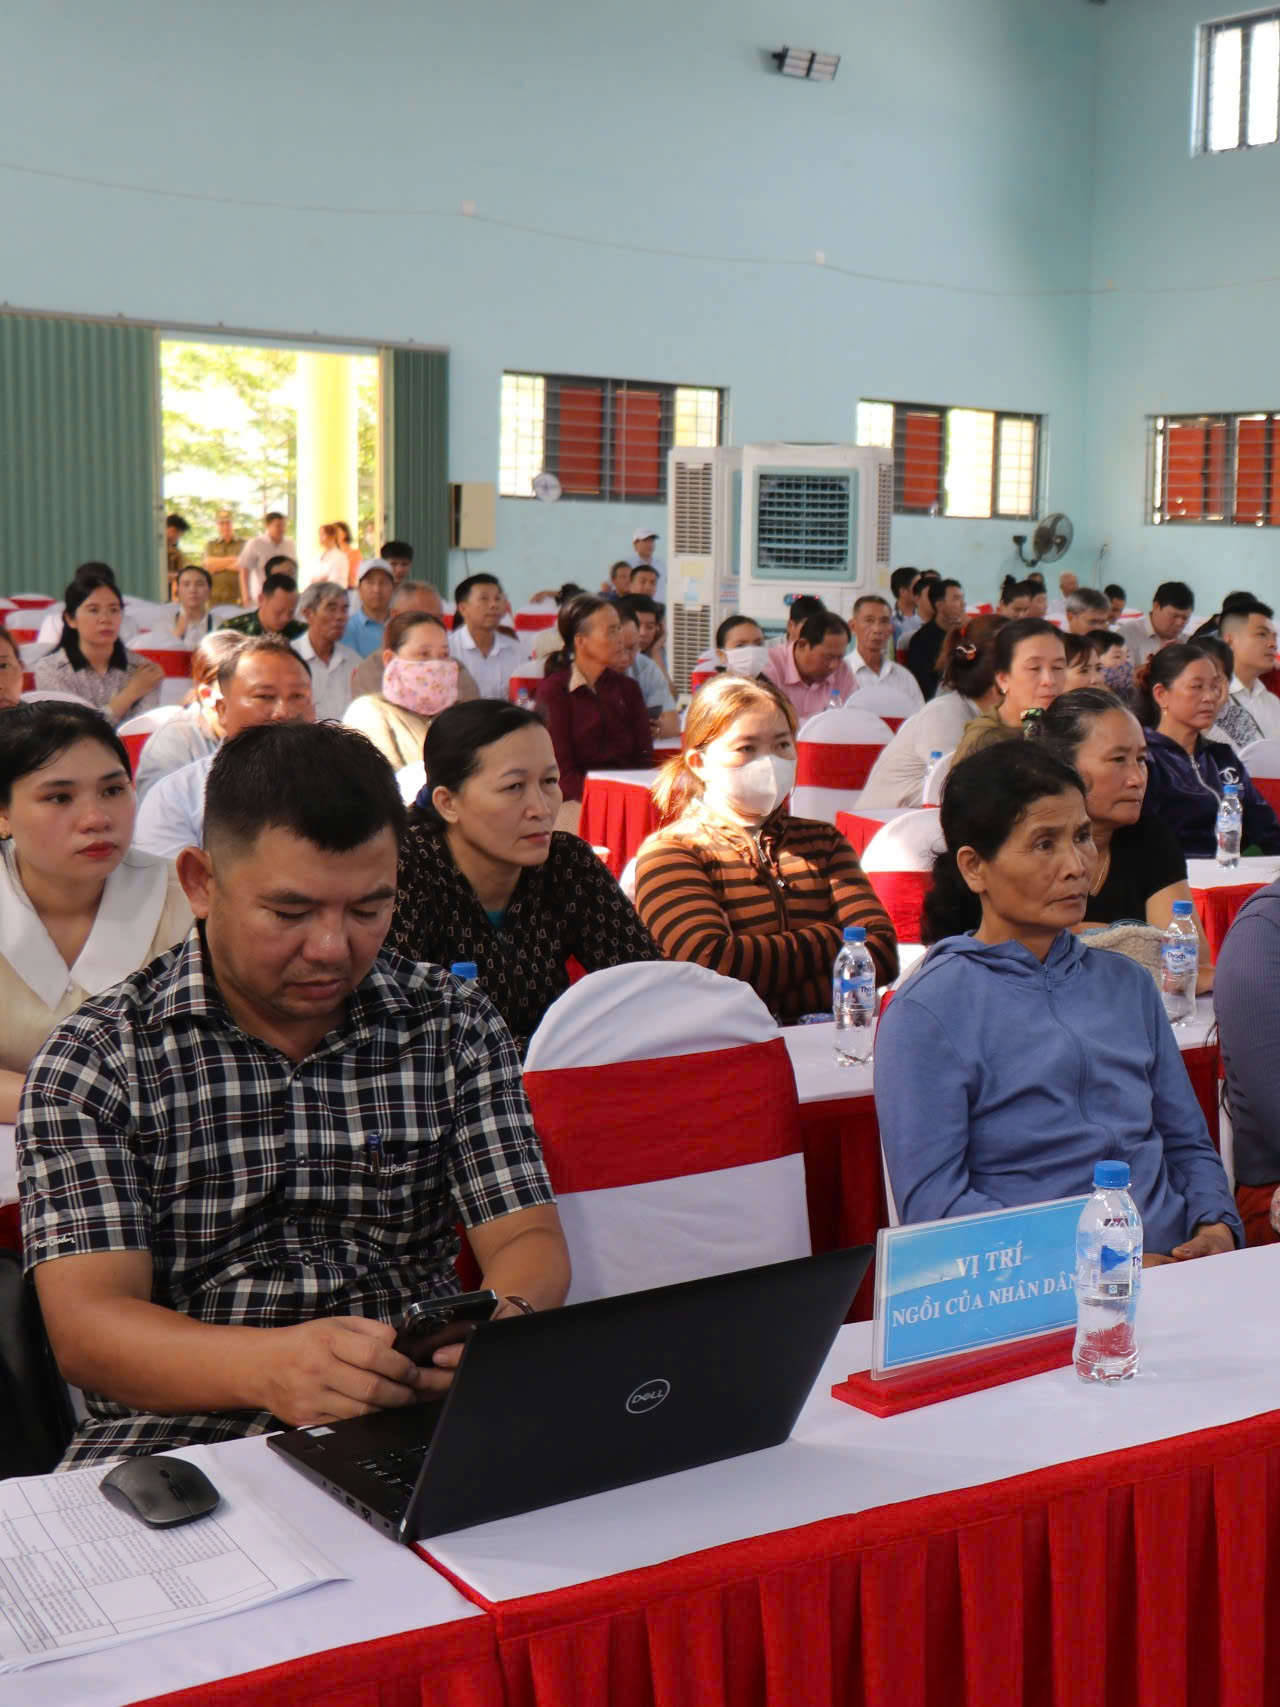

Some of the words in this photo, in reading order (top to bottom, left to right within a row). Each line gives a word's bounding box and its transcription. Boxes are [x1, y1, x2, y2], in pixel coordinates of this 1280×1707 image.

[956, 1254, 980, 1279] VỊ
[985, 1240, 1024, 1273] TRÍ
[891, 1295, 941, 1328] NGỒI
[945, 1289, 984, 1315] CỦA
[989, 1279, 1040, 1307] NHÂN
[631, 1389, 664, 1404] DELL
